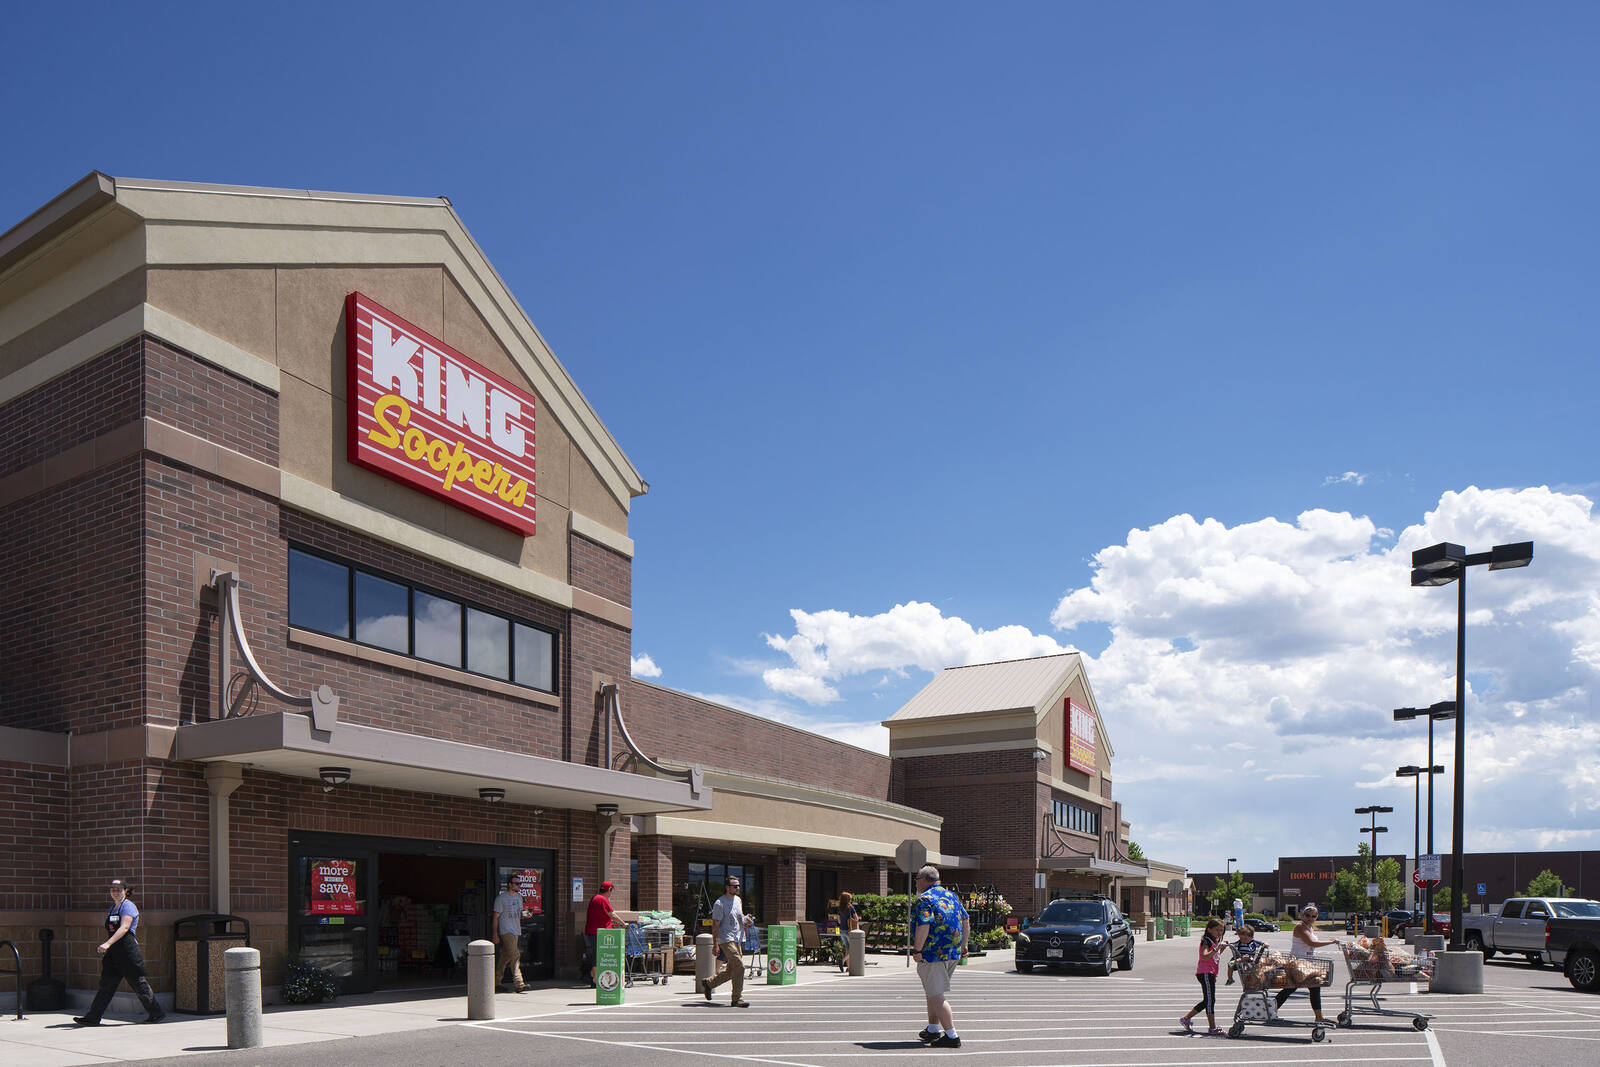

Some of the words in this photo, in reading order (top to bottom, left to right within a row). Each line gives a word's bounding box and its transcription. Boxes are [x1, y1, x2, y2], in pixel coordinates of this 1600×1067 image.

[372, 318, 526, 458] KING
[368, 394, 529, 508] Soopers
[1071, 705, 1095, 744] KING
[319, 866, 349, 876] more
[1290, 872, 1316, 880] HOME
[319, 883, 349, 894] save
